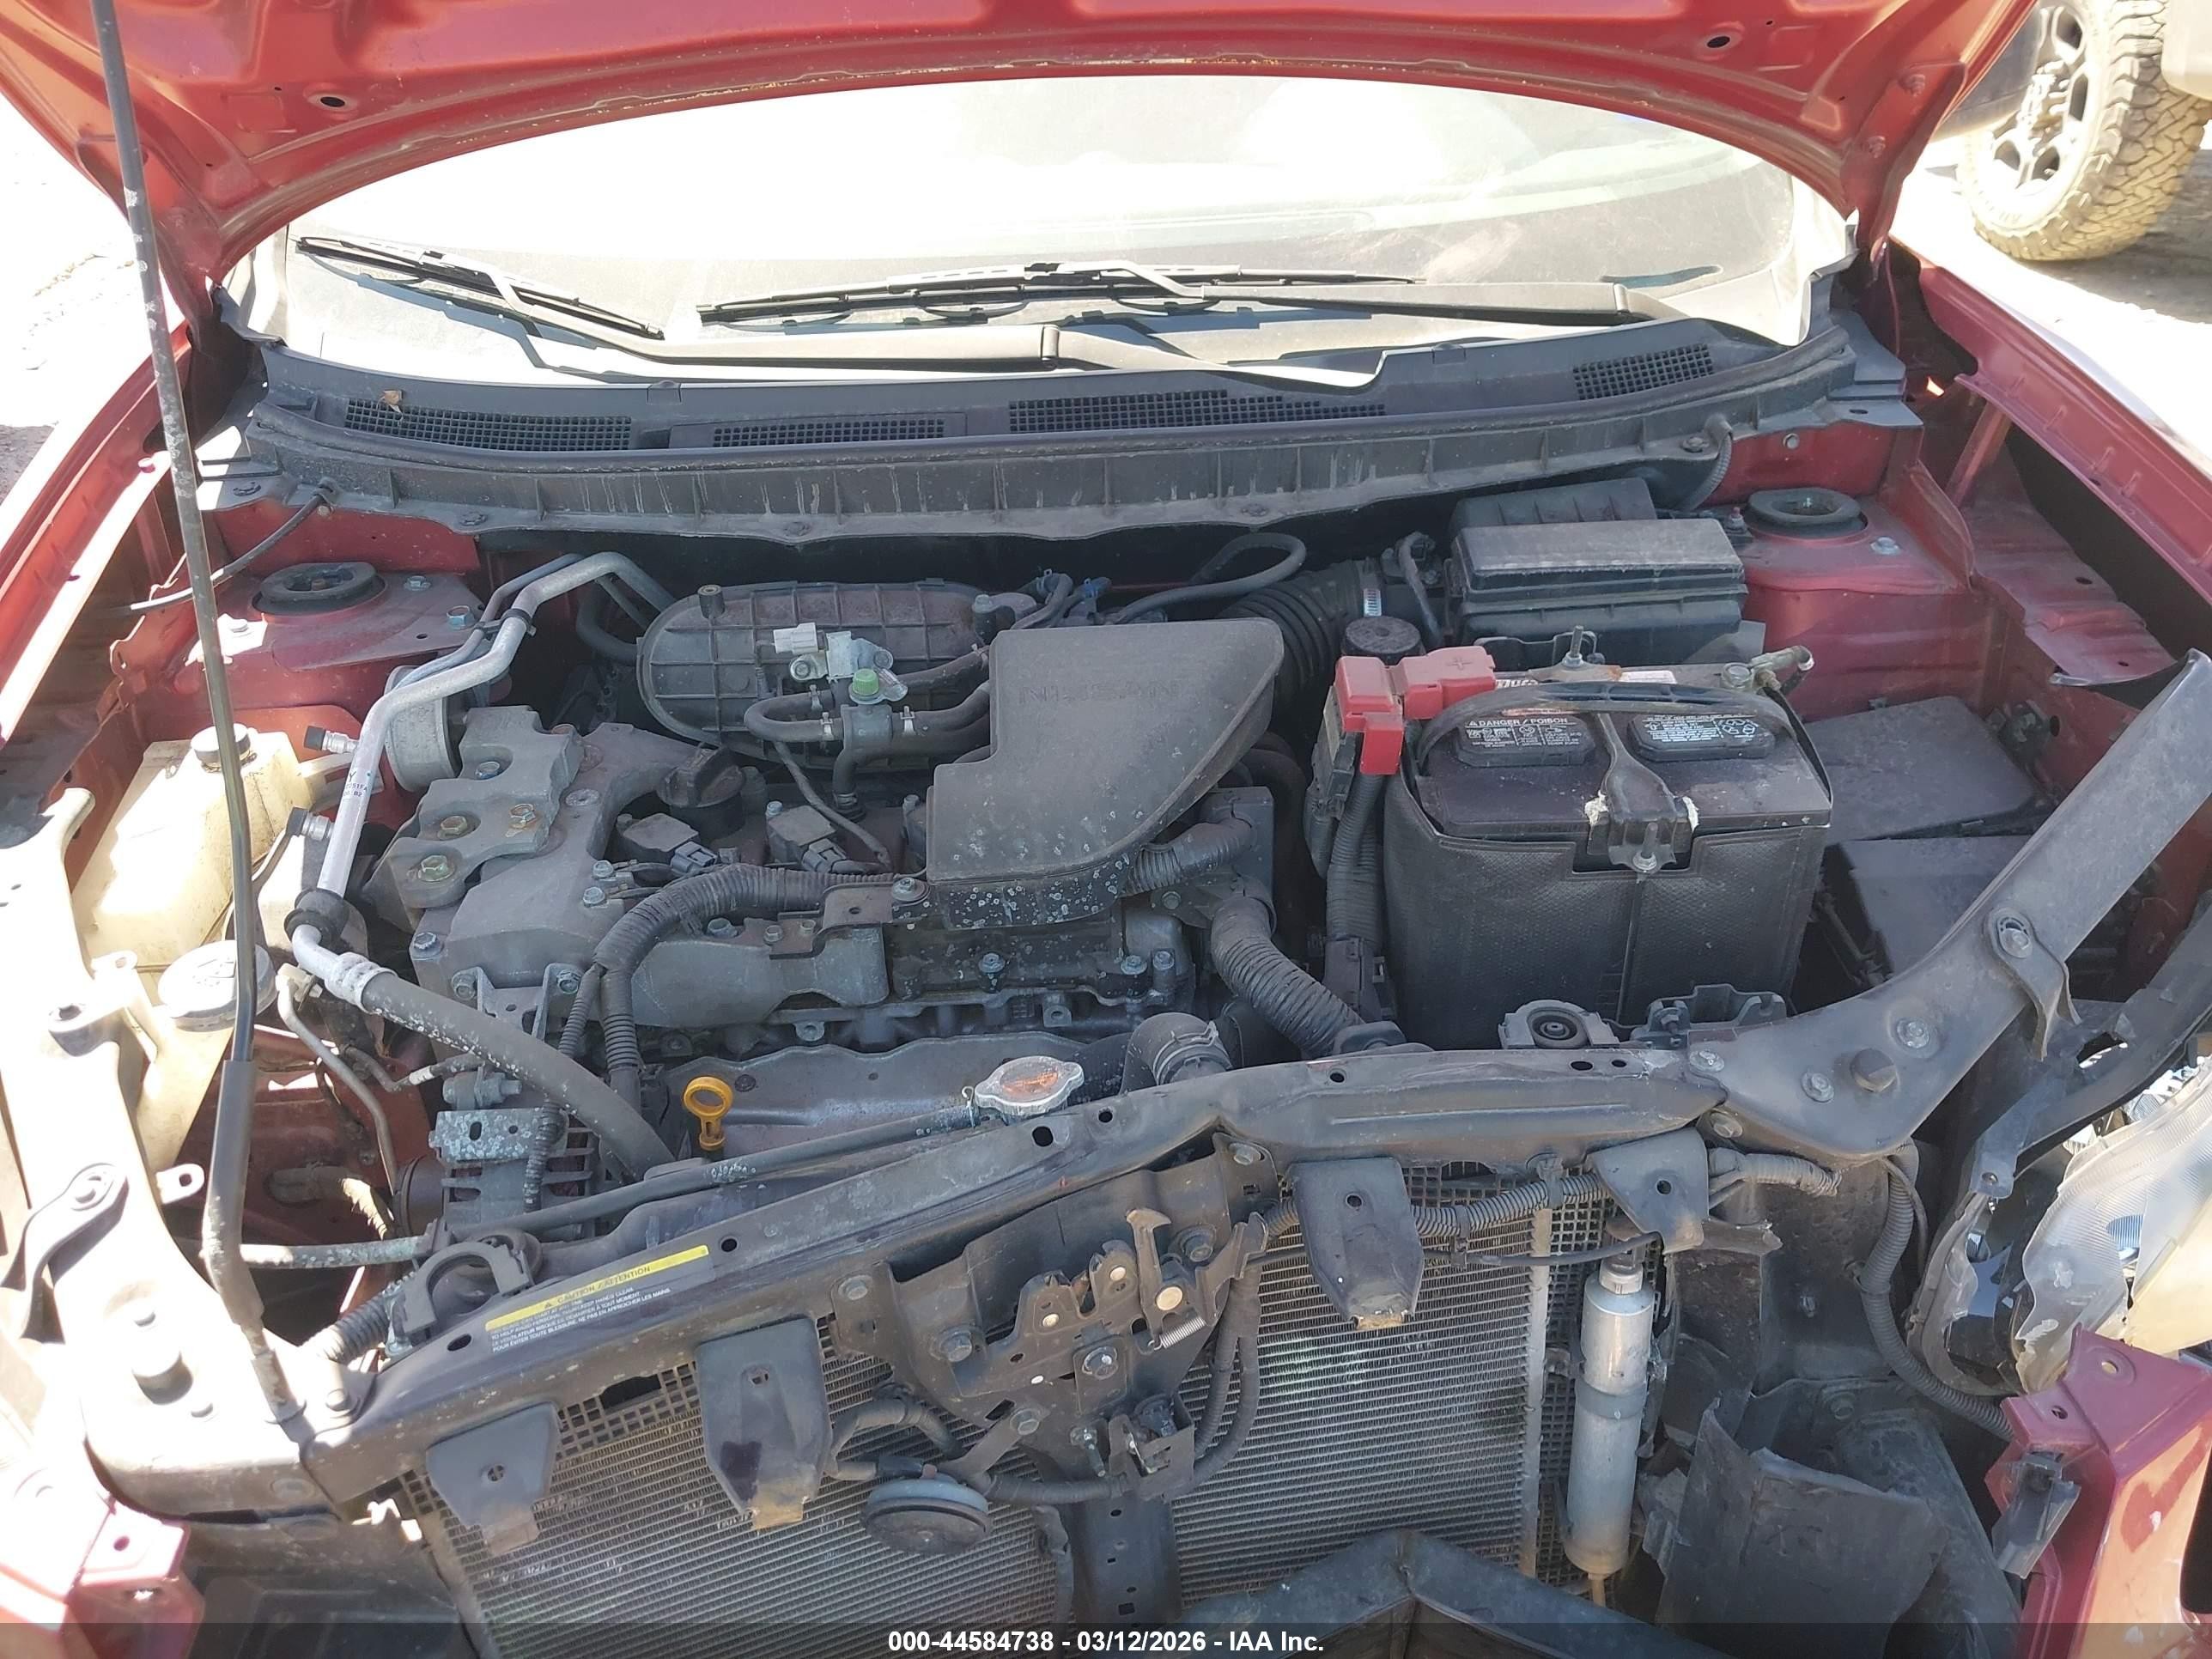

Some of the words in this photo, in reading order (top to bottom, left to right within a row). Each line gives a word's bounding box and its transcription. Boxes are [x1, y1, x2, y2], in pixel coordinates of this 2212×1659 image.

[557, 1285, 595, 1303] CAUTION
[604, 1265, 651, 1286] ATTENTION
[529, 1329, 547, 1340] TOUTE
